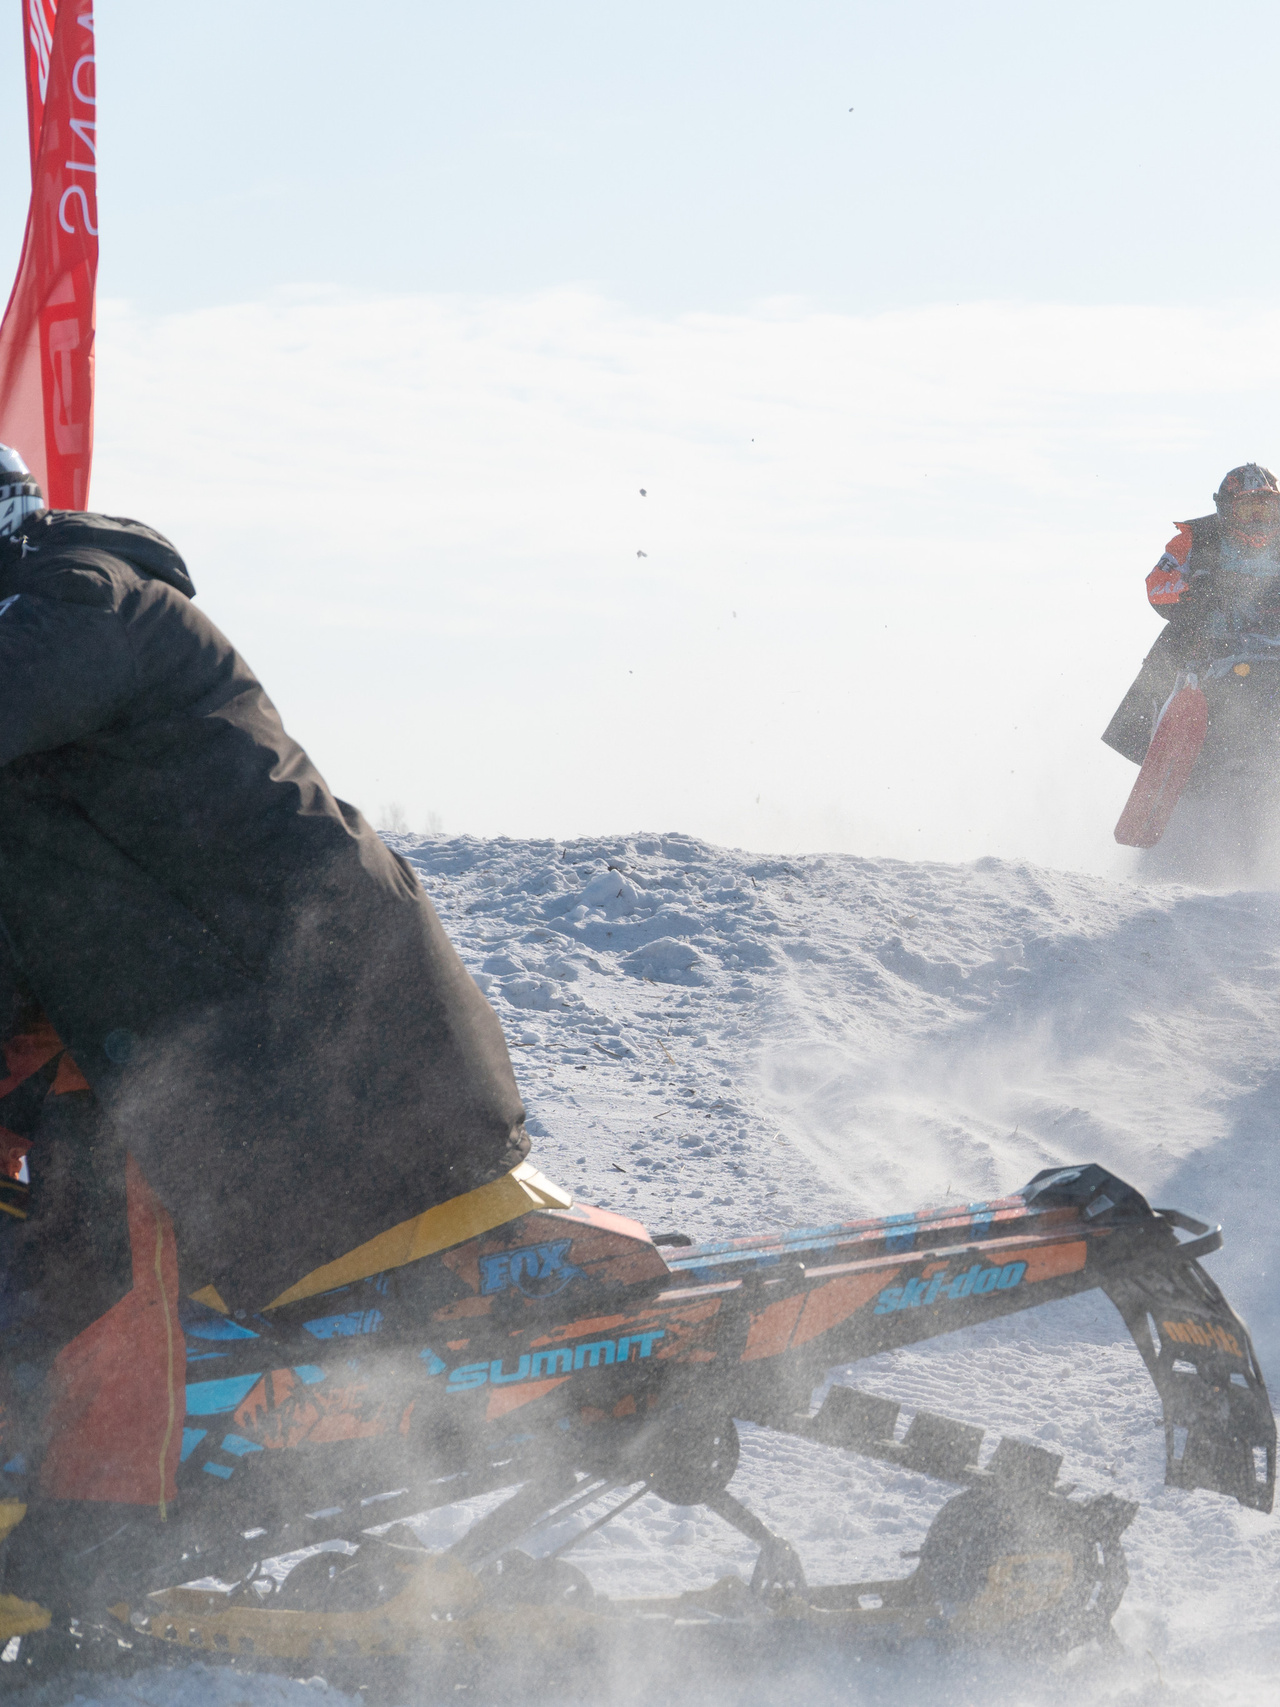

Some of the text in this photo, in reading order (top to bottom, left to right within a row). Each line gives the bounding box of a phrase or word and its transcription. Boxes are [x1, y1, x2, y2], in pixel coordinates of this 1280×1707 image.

[480, 1238, 582, 1298] FOX
[873, 1262, 1026, 1315] ski-doo
[446, 1330, 665, 1394] SUMMIT
